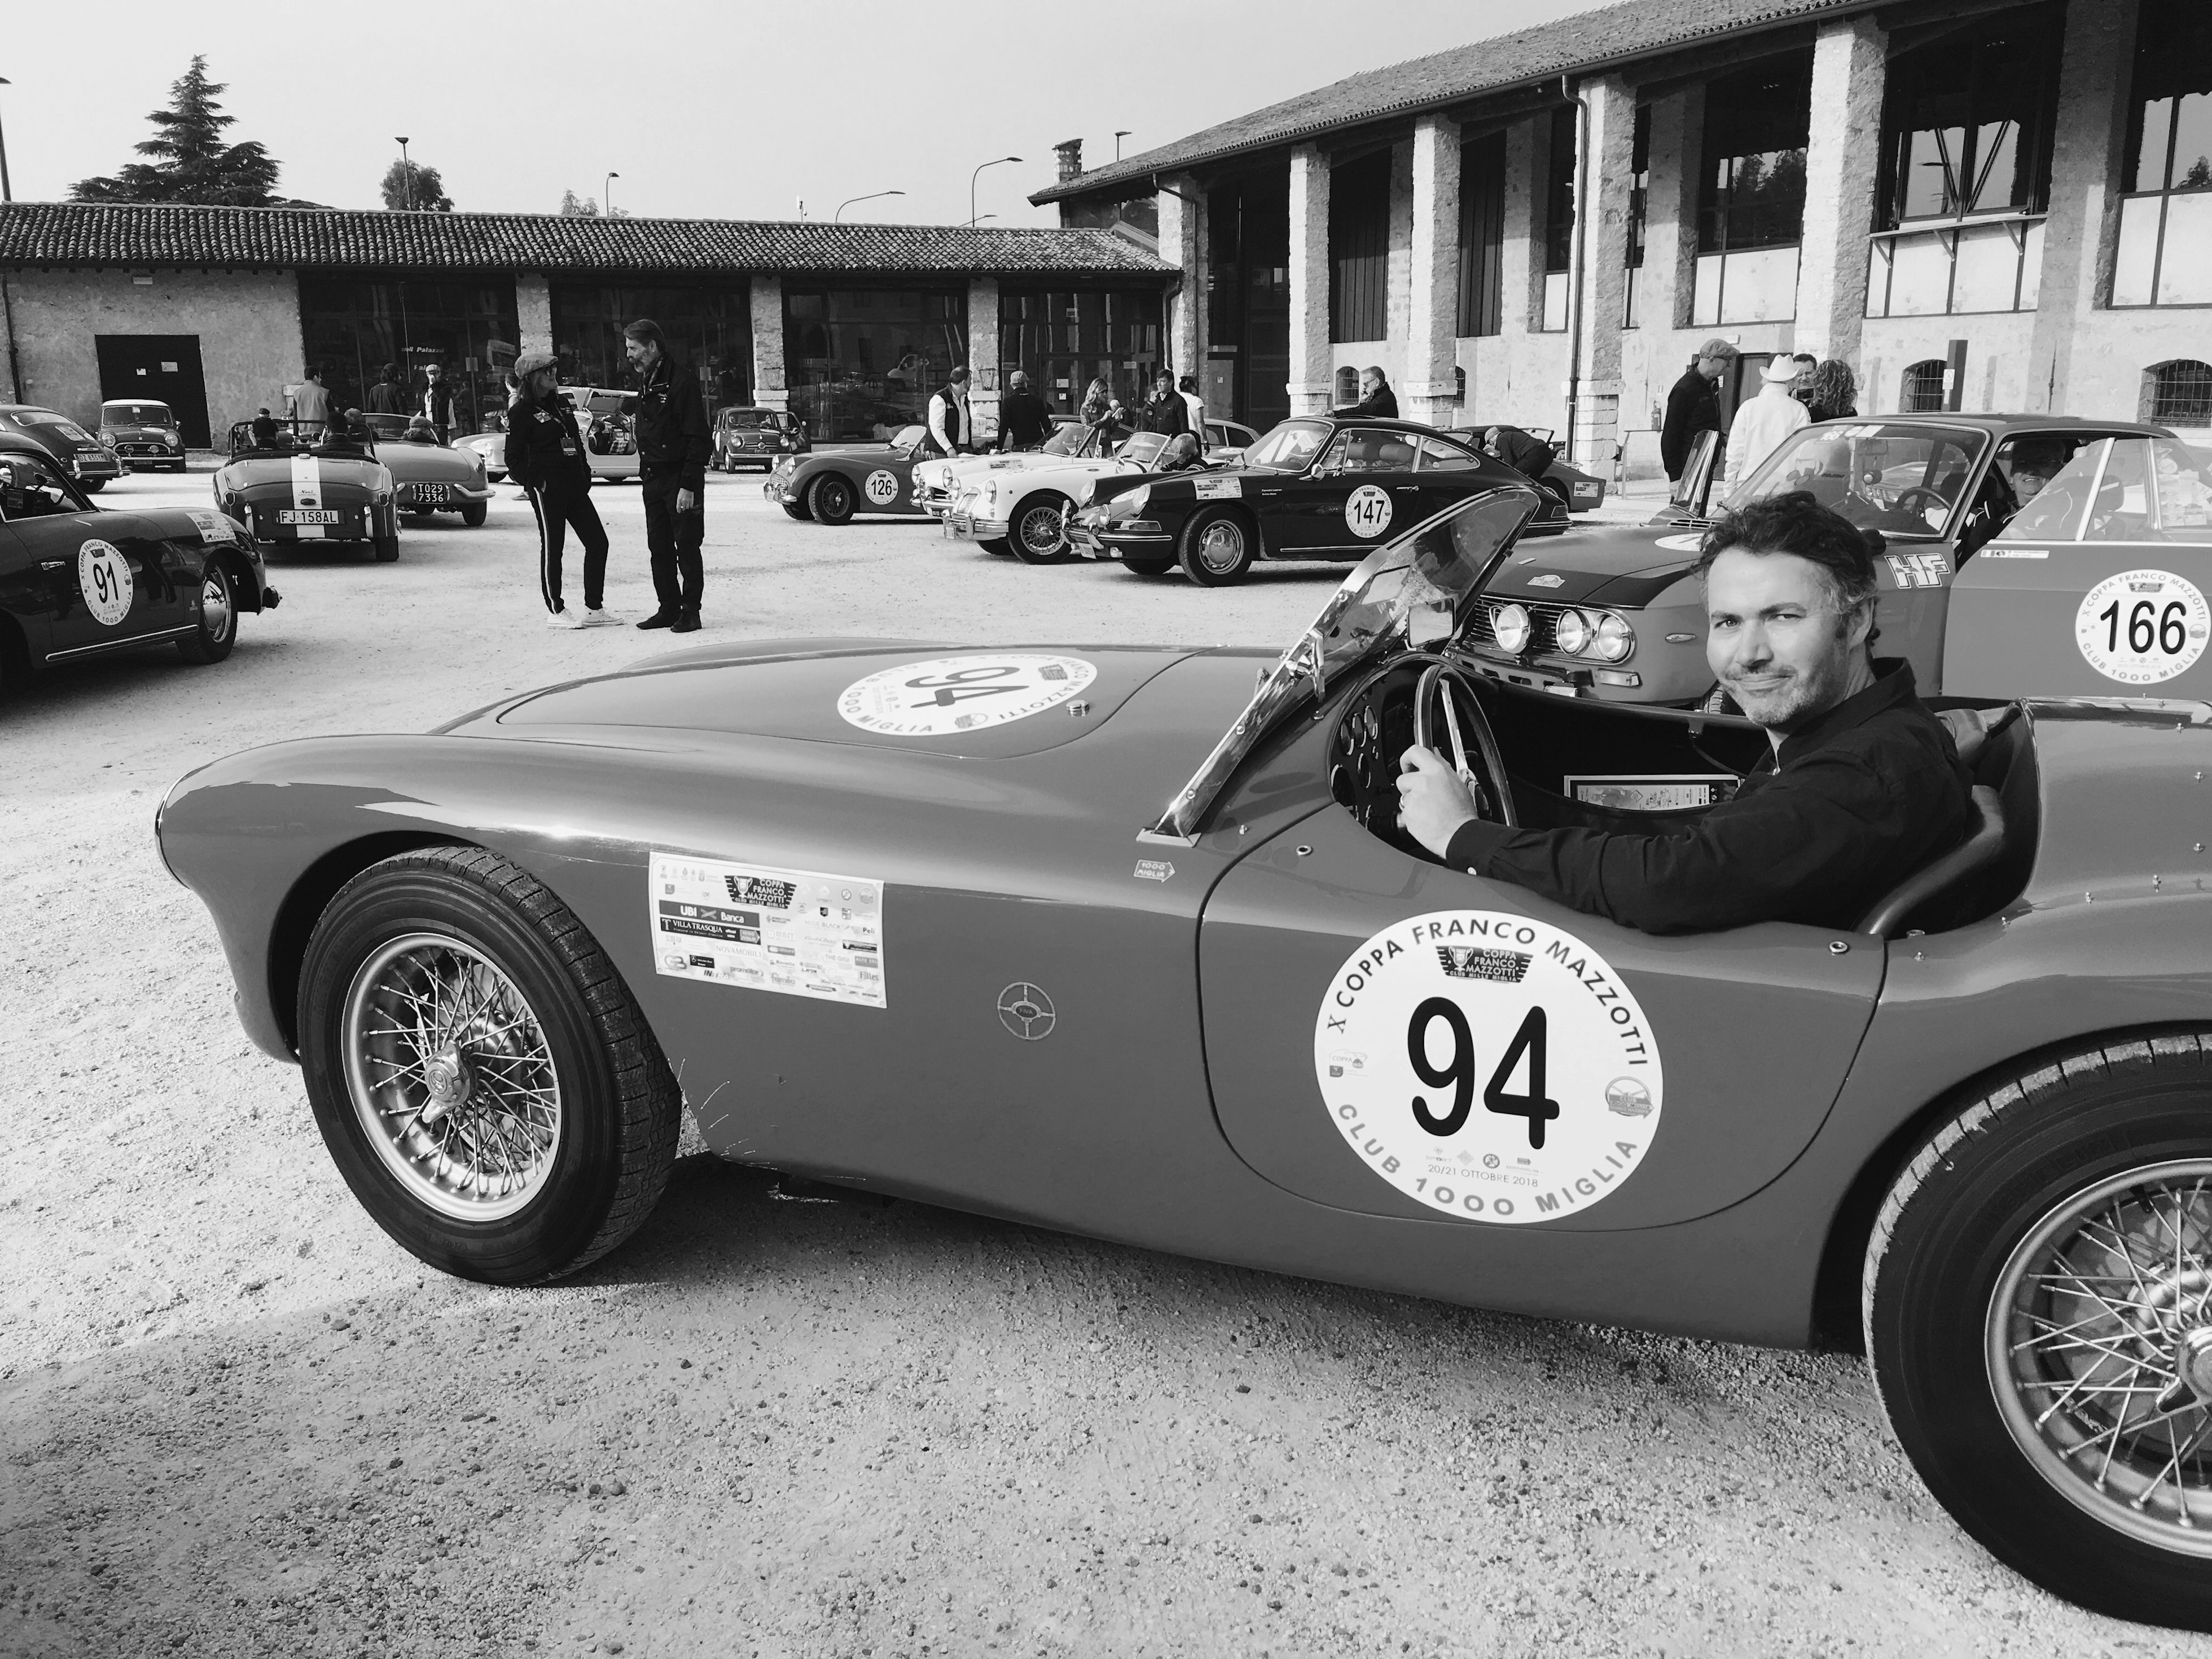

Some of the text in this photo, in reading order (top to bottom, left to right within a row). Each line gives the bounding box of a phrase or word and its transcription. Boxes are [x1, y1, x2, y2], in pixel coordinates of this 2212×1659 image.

[418, 493, 444, 502] 7336
[871, 479, 892, 495] 126
[281, 512, 337, 522] FJ 158AL
[1354, 499, 1385, 524] 147
[84, 541, 103, 552] FRANCO
[104, 544, 128, 571] MAZZOTTI
[1884, 553, 1950, 589] HF
[93, 561, 119, 604] 91
[88, 600, 100, 618] CLUB
[120, 592, 132, 618] MIGLIA
[2086, 581, 2116, 607] COPPA
[2118, 573, 2166, 584] FRANCO
[2169, 578, 2206, 620] MAZZOTTI
[2100, 600, 2187, 654] 166
[1056, 659, 1089, 679] FRANCO
[2083, 643, 2200, 681] CLUB 1000 MIGLIA
[904, 666, 1030, 709] 94
[844, 665, 933, 732] CLUB 1000 MIGLIA
[999, 681, 1084, 719] MAZZOTTI
[1137, 869, 1165, 878] MIGLIA
[1141, 862, 1165, 870] 1000
[752, 885, 784, 896] FRANCO
[759, 878, 785, 889] COPPA
[747, 892, 784, 904] MAZZOTTI
[680, 905, 744, 923] UBI Banca
[672, 919, 691, 929] VILLA
[691, 922, 723, 933] TRASQUA
[715, 945, 761, 958] NOVAMOBILI
[1474, 956, 1516, 968] FRANCO
[1483, 949, 1517, 960] COPPA
[1465, 964, 1516, 976] MAZZOTTI
[1327, 918, 1648, 1066] X COPPA FRANCO MAZZOTTI
[1407, 997, 1560, 1150] 94
[1338, 1103, 1638, 1216] CLUB 1000 MIGLIA
[1428, 1164, 1539, 1187] 20/21 OTTOBRE 2018
